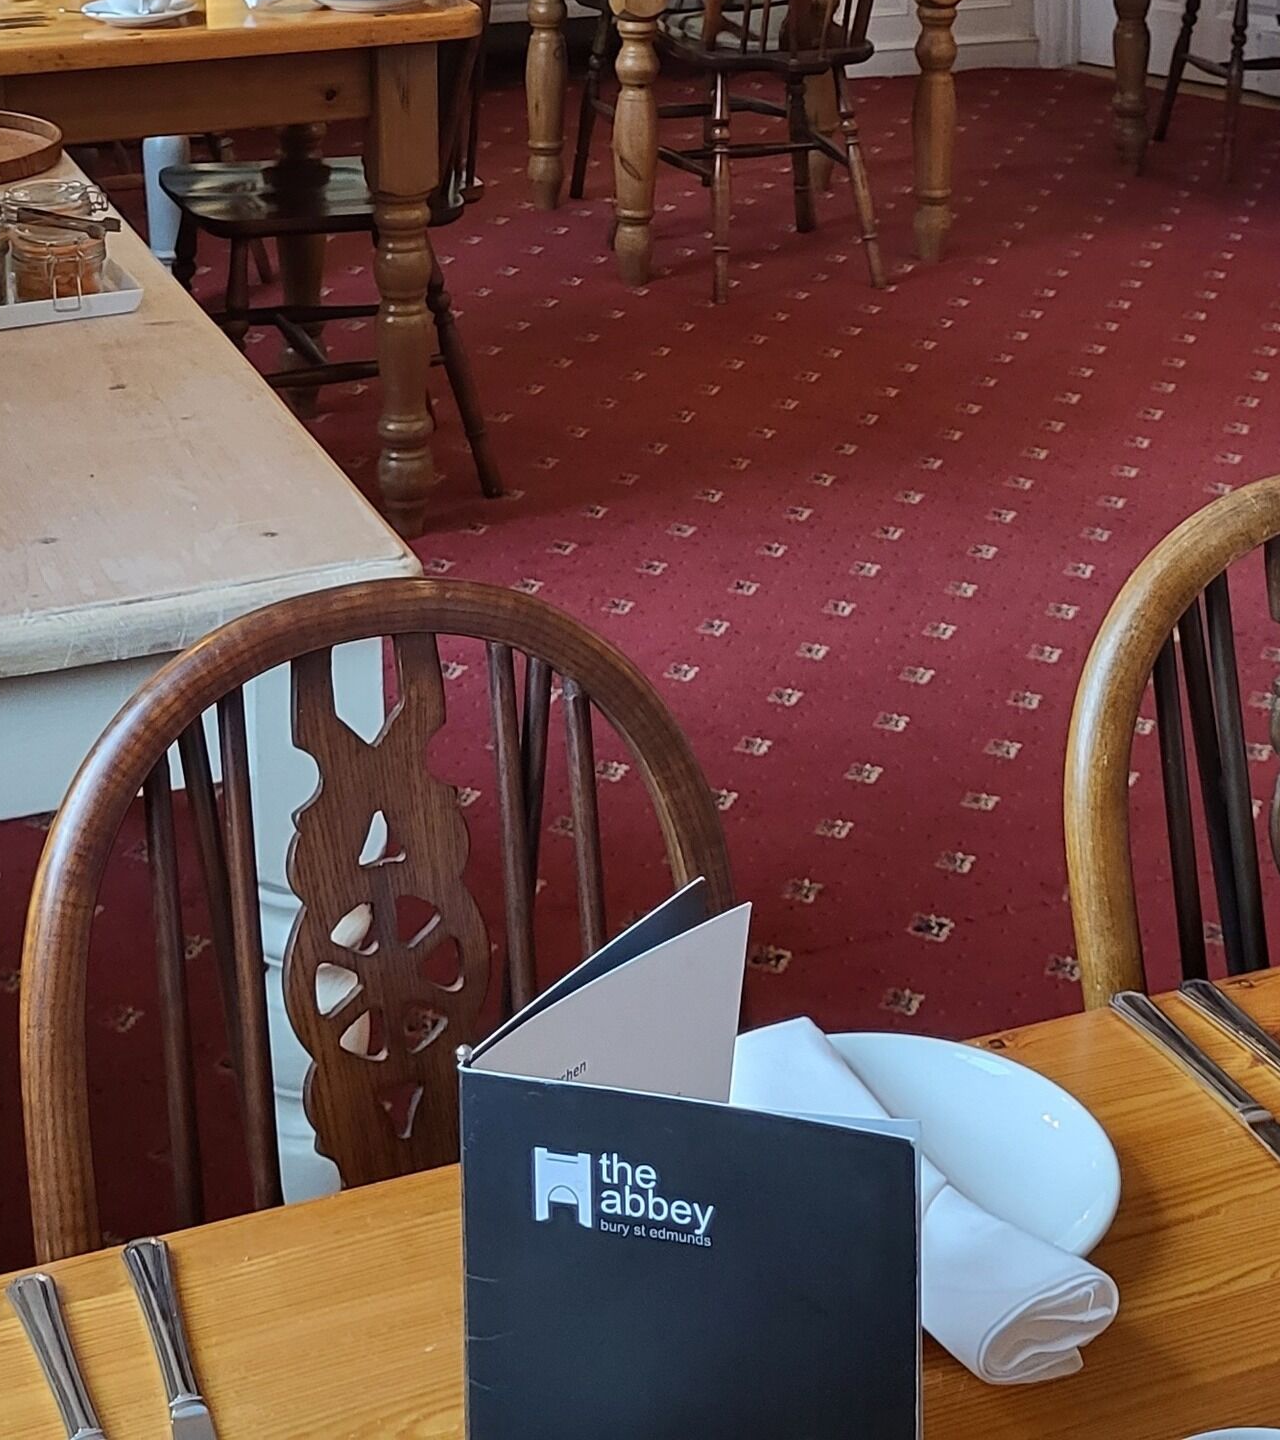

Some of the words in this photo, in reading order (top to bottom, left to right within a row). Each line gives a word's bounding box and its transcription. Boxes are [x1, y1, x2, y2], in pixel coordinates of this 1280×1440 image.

[598, 1152, 658, 1189] the
[600, 1184, 715, 1236] abbey
[600, 1219, 630, 1238] bury
[633, 1224, 646, 1237] st
[649, 1227, 712, 1248] edmunds
